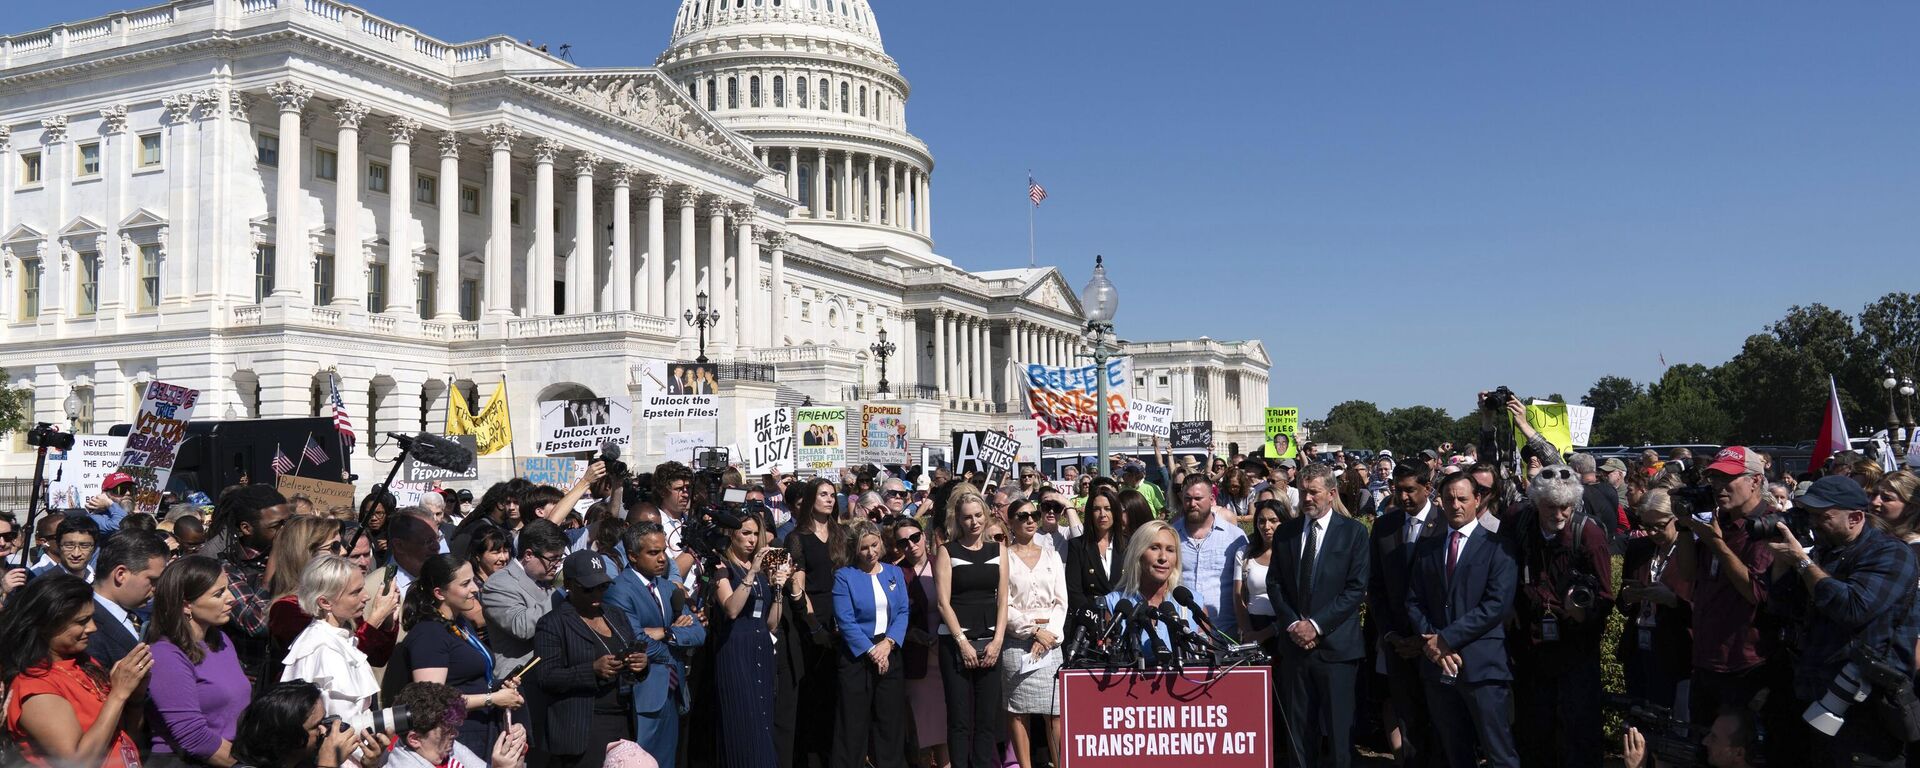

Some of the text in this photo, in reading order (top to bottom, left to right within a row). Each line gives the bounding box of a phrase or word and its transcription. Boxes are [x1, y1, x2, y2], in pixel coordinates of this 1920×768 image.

[147, 381, 199, 410] BELIEVE
[651, 396, 710, 406] Unlock the
[156, 402, 178, 419] THE
[644, 408, 719, 420] Epstein Files!
[797, 410, 846, 420] FRIENDS
[864, 405, 902, 414] PEDOPHILE
[1132, 402, 1172, 416] DO RIGHT
[754, 408, 787, 433] HE IS
[1526, 406, 1565, 429] RUST
[554, 426, 620, 439] Unlock the
[758, 422, 790, 442] ON the
[1128, 420, 1169, 436] WRONGED
[545, 436, 630, 452] Epstein Files!
[985, 430, 1018, 456] RELEASE
[122, 451, 148, 466] THE
[755, 437, 792, 469] LIST!
[956, 433, 985, 475] A
[984, 448, 1013, 470] FILES
[526, 458, 574, 471] BELIEVE
[281, 476, 354, 498] Believe Survivors
[408, 492, 420, 502] TH
[591, 557, 602, 568] NY
[1085, 608, 1098, 624] svt
[1103, 705, 1228, 729] EPSTEIN FILES
[1075, 732, 1257, 757] TRANSPARENCY ACT
